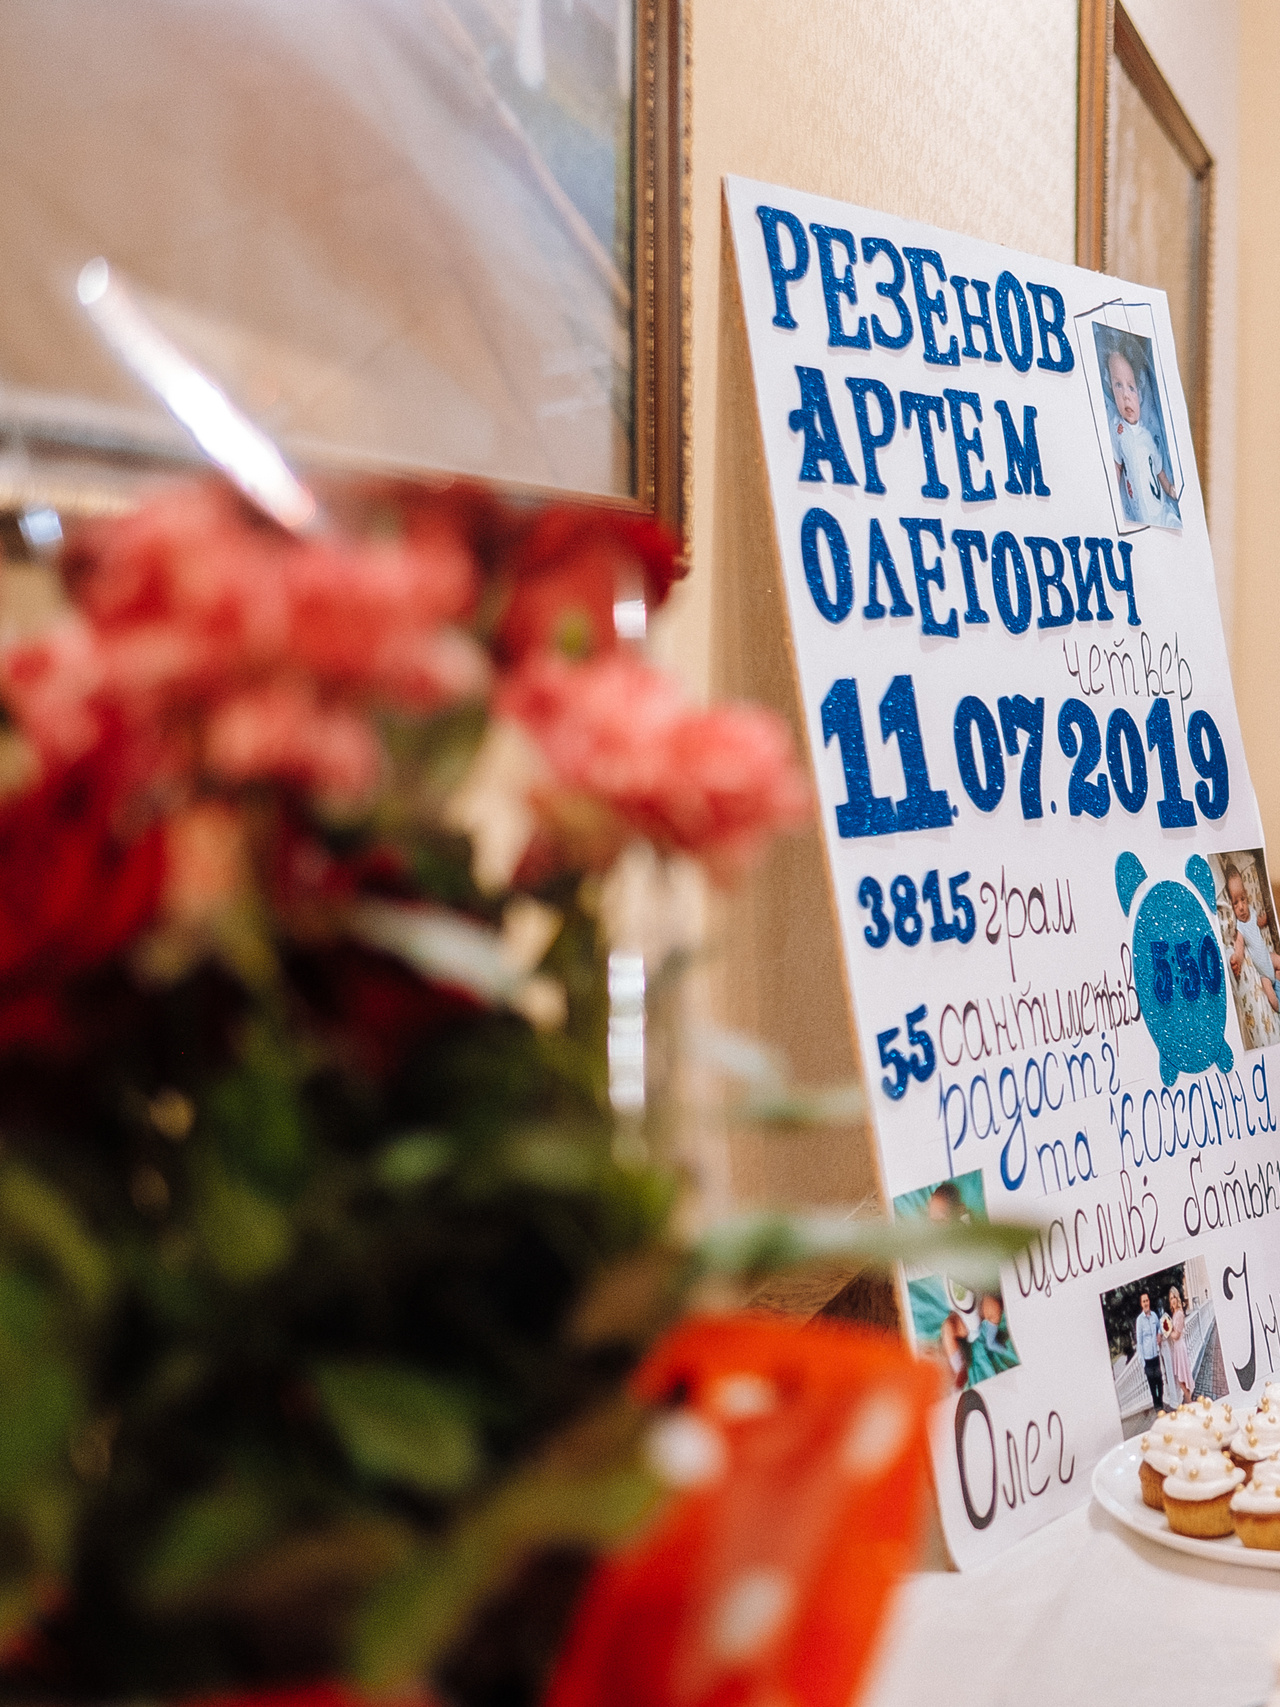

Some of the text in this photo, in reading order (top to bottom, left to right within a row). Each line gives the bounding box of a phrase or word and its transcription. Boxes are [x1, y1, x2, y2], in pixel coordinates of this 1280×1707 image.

[757, 204, 1076, 374] РЕЗЕНОВ
[788, 364, 1052, 502] АРТЕМ
[800, 506, 1142, 639] ОЛЕГОВИЧ
[1063, 631, 1194, 733] четвер
[820, 673, 1230, 839] 11.07.2019
[857, 864, 1078, 983] 3815 грам
[876, 942, 1142, 1101] 55 сантиметрів
[937, 1031, 1122, 1191] радості
[1034, 1053, 1278, 1196] та кохання
[954, 1389, 1076, 1530] Олег
